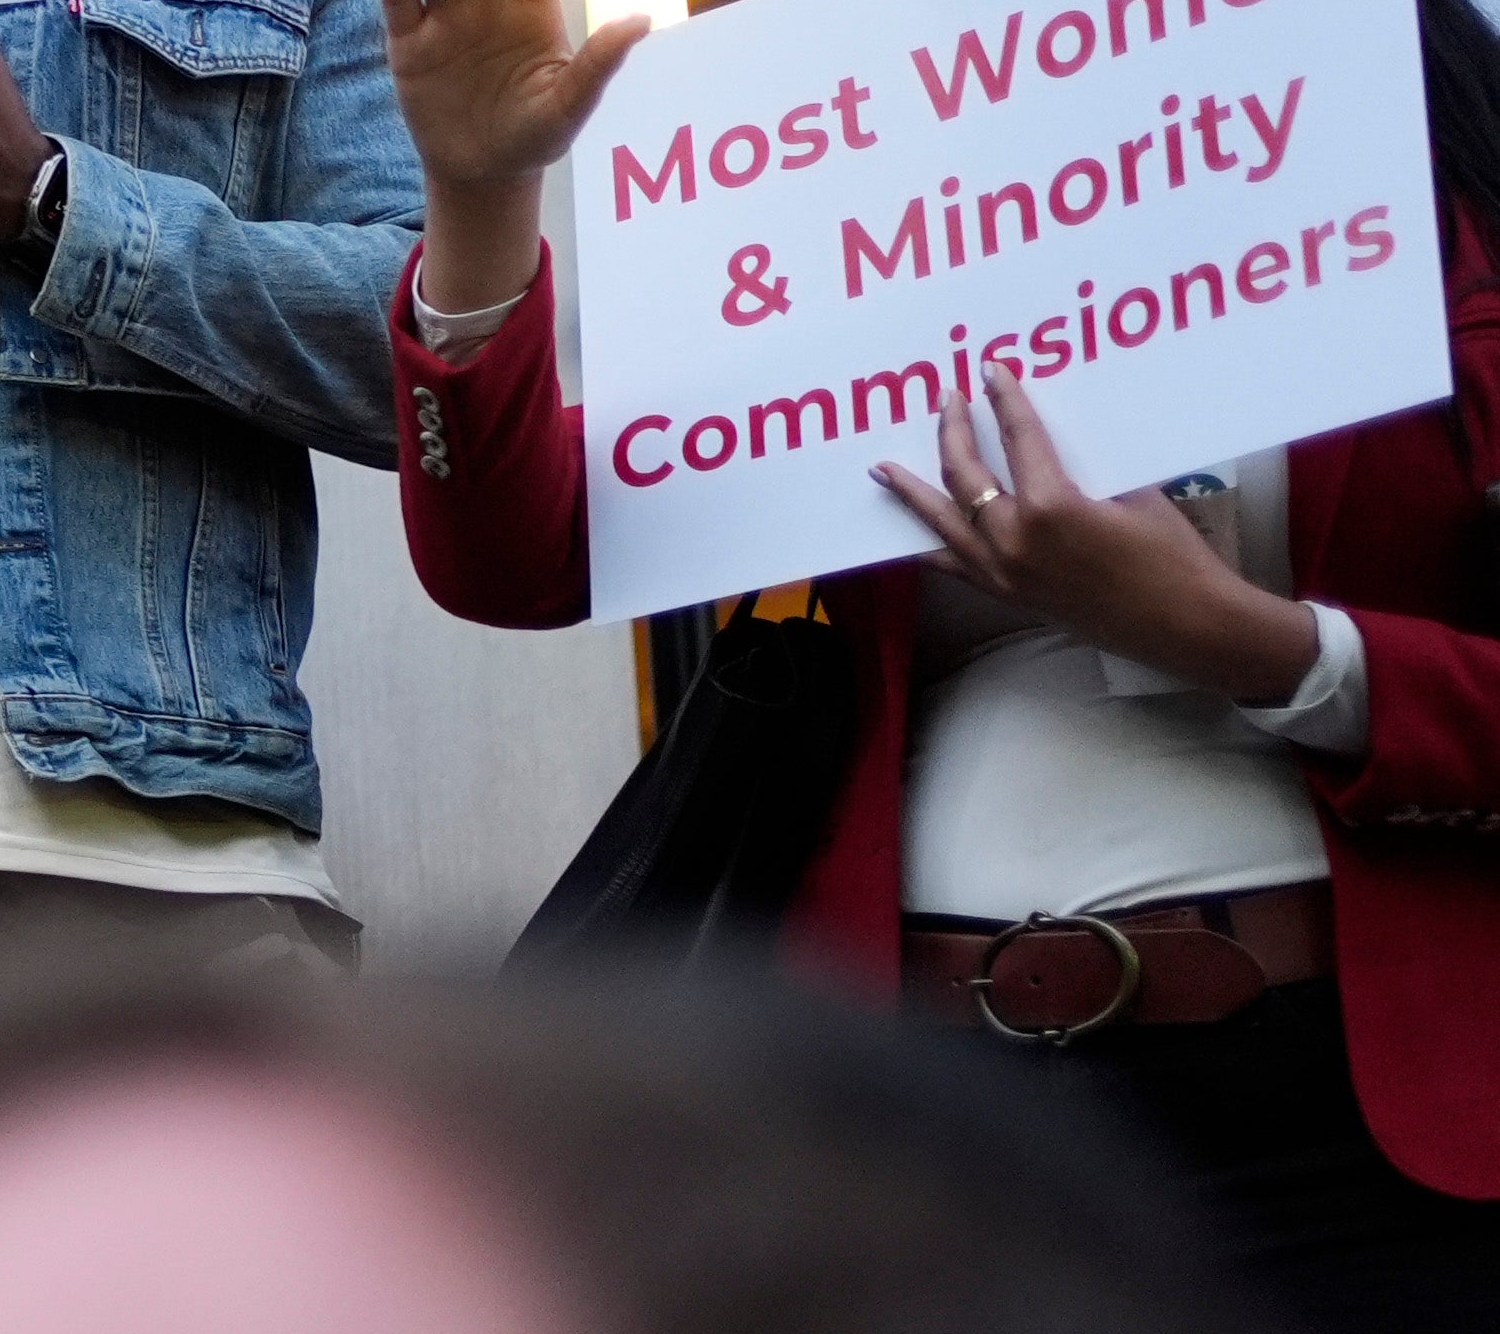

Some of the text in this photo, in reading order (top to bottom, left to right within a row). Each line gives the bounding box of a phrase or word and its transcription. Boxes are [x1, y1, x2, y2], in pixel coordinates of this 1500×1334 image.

[612, 77, 878, 222] Most
[721, 77, 1304, 326] & Minority
[612, 206, 1394, 487] Commissioners
